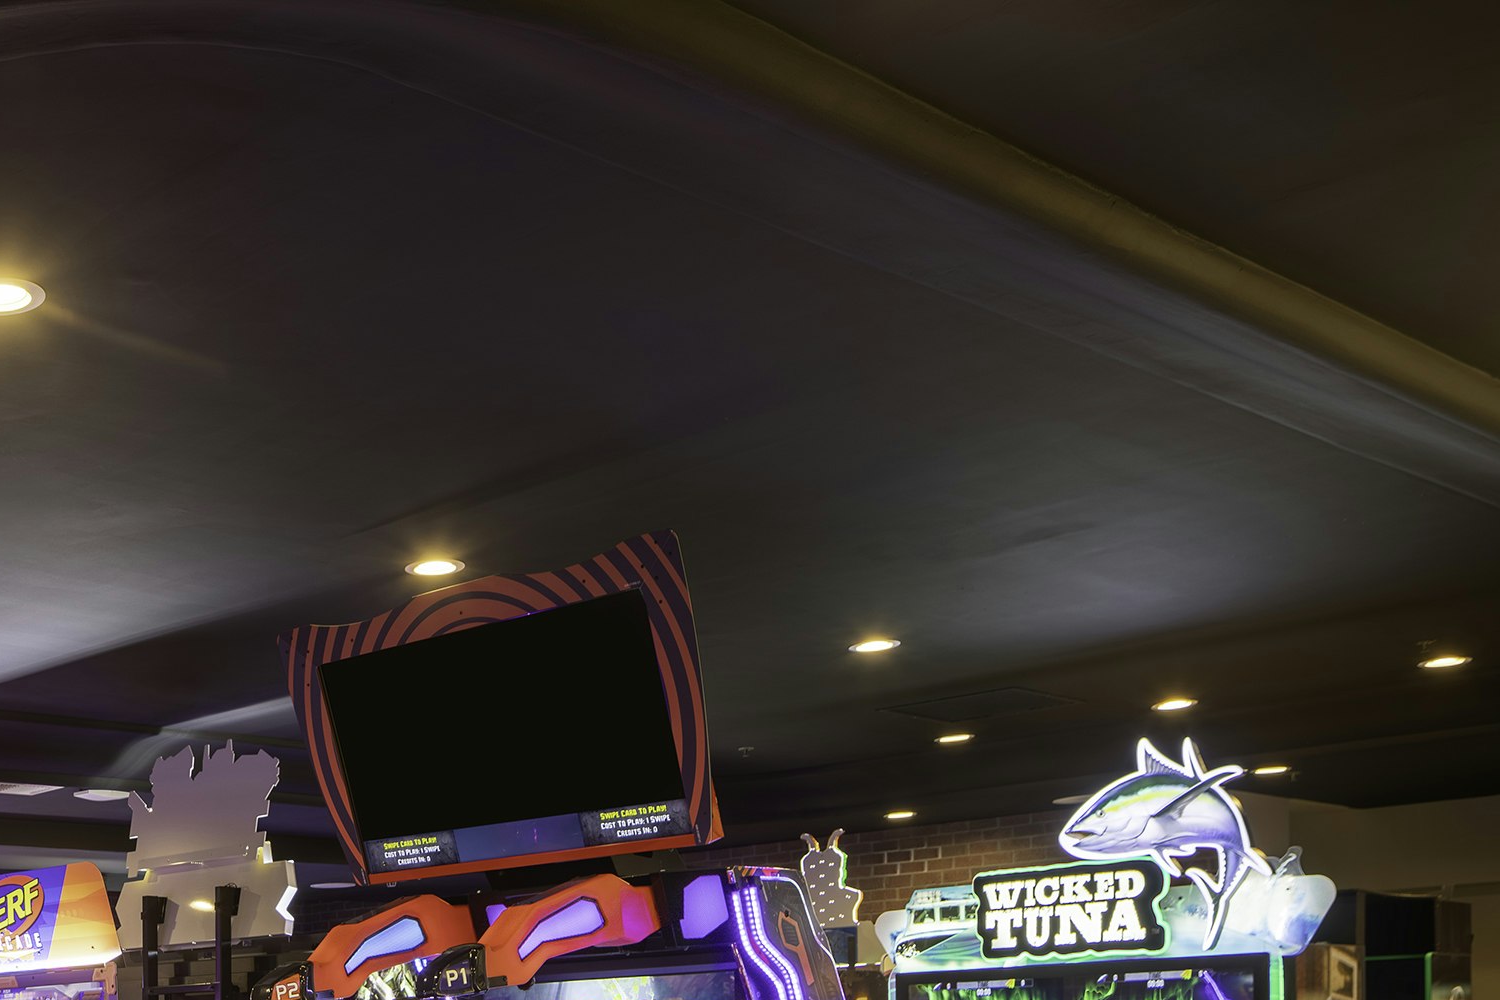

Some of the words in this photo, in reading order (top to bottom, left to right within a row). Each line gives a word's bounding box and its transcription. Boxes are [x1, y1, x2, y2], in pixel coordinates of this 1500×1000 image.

[983, 869, 1146, 910] WICKED
[985, 898, 1147, 950] TUNA
[275, 983, 300, 1000] P2
[446, 967, 468, 987] P1
